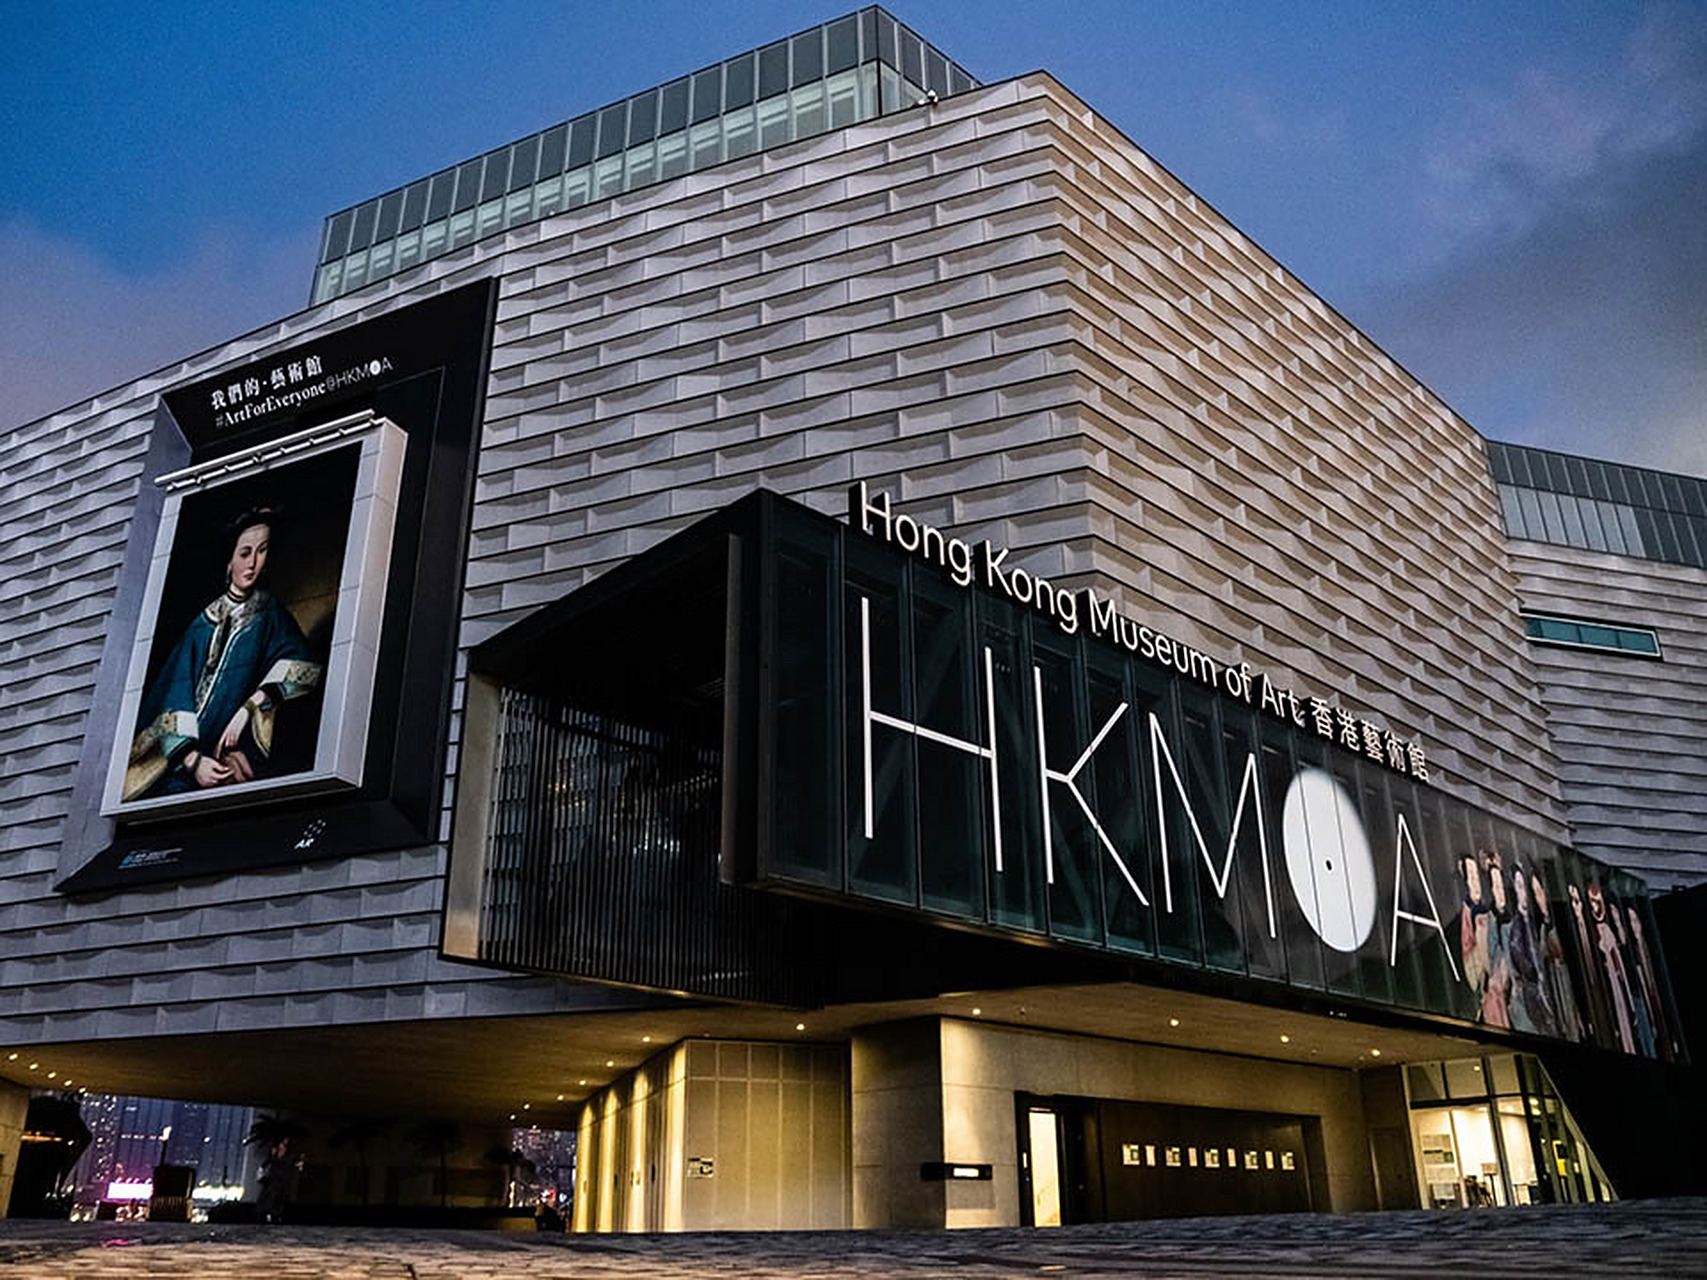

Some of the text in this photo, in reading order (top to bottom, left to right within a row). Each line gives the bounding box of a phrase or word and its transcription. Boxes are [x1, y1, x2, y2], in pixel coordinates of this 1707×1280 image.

[861, 481, 1430, 782] Hong Kong Museum of Art 香港藝術館
